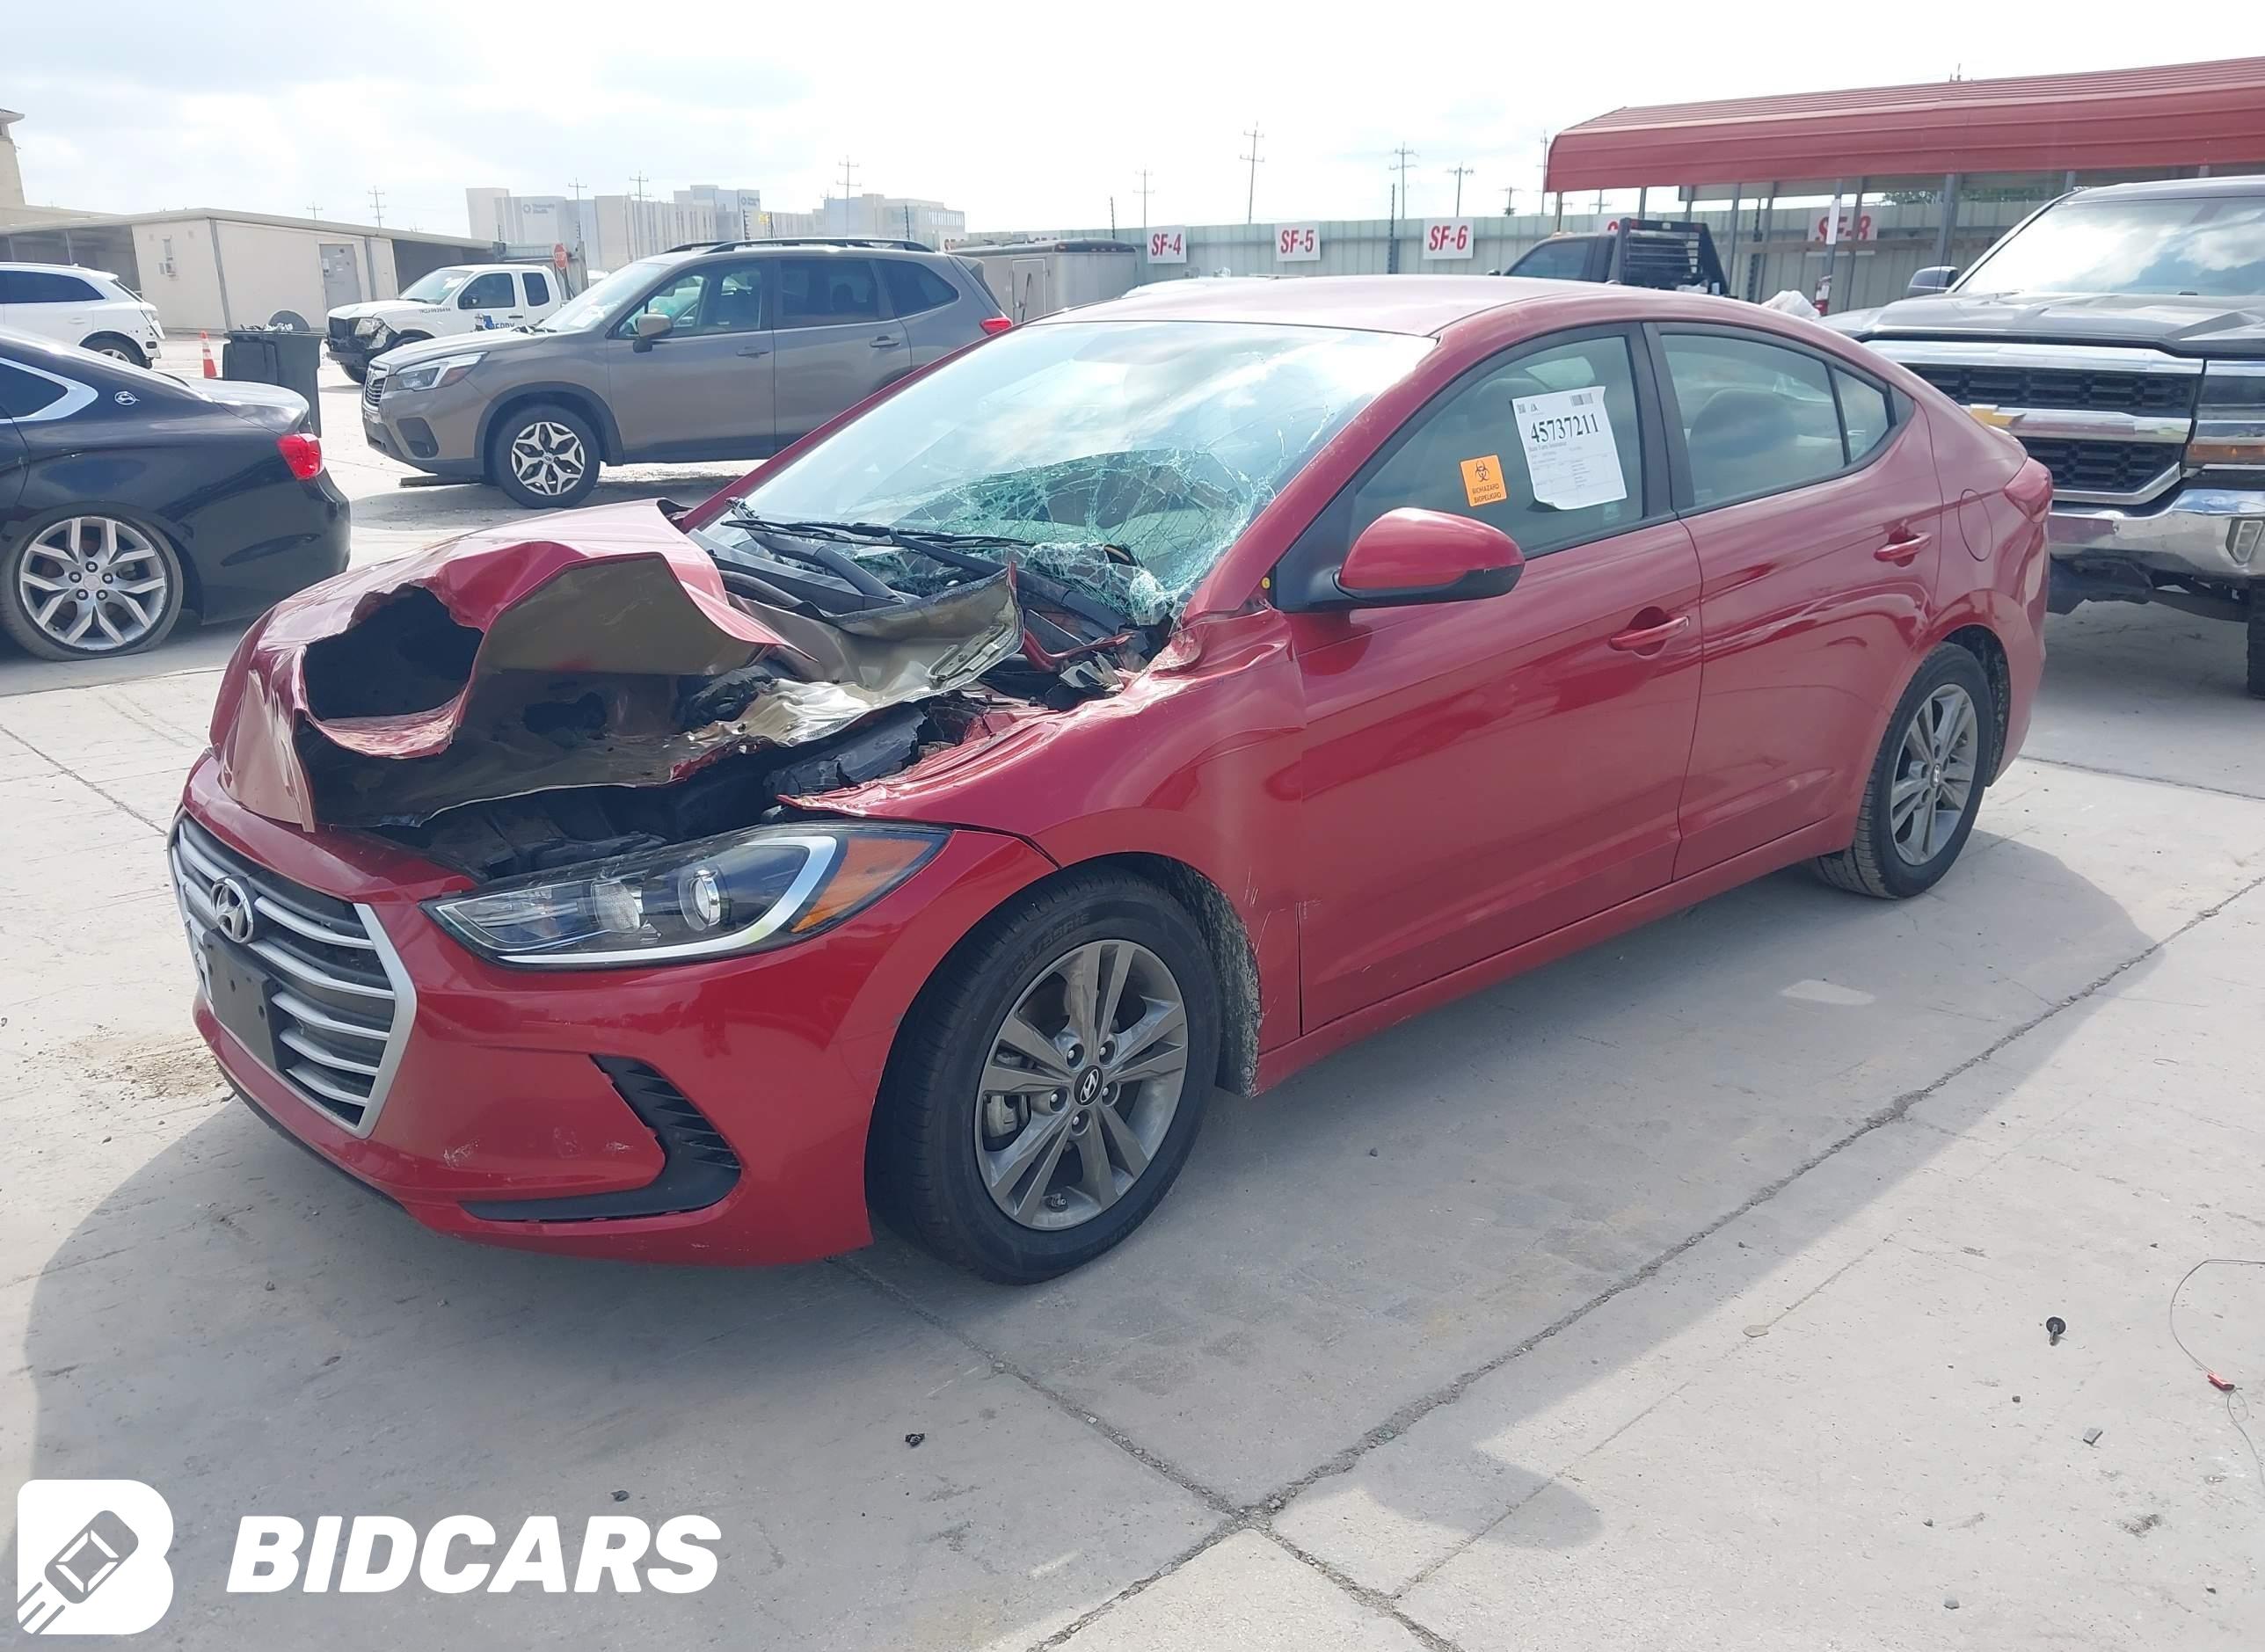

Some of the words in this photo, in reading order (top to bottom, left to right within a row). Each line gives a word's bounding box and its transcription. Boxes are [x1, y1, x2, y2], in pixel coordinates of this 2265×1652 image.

[1152, 233, 1182, 257] SF-4
[1280, 229, 1315, 253] SF-5
[1429, 225, 1468, 251] SF-6
[1532, 413, 1599, 442] 45737211
